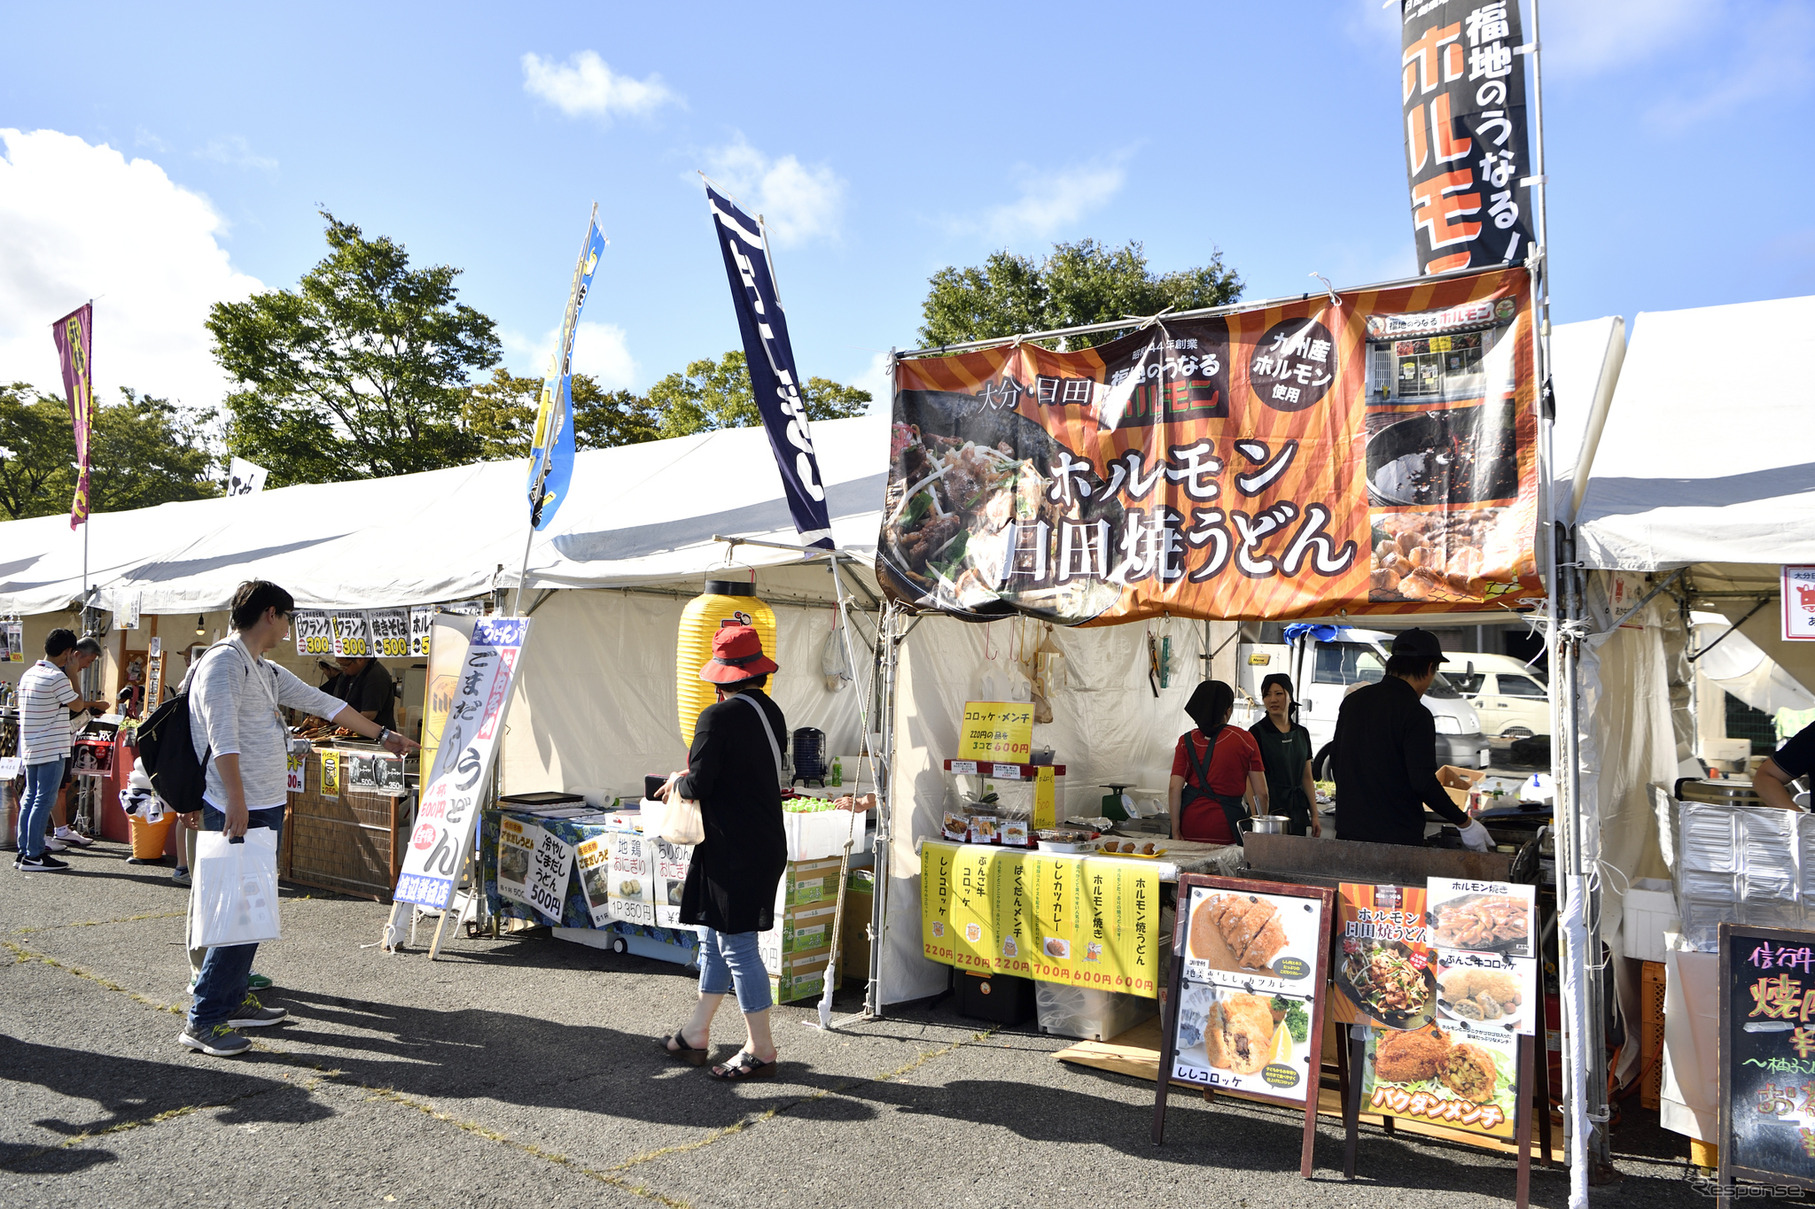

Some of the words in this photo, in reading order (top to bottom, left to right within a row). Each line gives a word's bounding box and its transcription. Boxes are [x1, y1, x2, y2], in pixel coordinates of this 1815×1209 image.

[1402, 21, 1482, 275] ホルモ
[1439, 306, 1491, 324] ホルモン
[1269, 331, 1331, 363] 九州産
[1252, 354, 1333, 387] ホルモン
[1271, 383, 1301, 404] 使用
[1047, 441, 1296, 508] ホルモン
[1000, 503, 1354, 583] 日田焼うどん
[302, 619, 330, 635] フランク
[339, 619, 367, 636] フランク
[965, 711, 1031, 724] コロッケ・メンチ
[541, 834, 566, 860] 冷やし
[613, 855, 647, 876] おにぎり
[938, 856, 948, 917] ししコロッケ
[962, 867, 971, 907] コロッケ
[976, 856, 987, 898] ぶんご牛
[1452, 881, 1508, 895] ホルモン焼き
[530, 883, 561, 916] 500円
[1013, 865, 1024, 938] ばくだんメンチ
[1053, 860, 1063, 932] ししカツカレー
[1092, 874, 1103, 940] ホルモン焼き
[1358, 908, 1420, 926] ホルモン
[1345, 921, 1427, 944] 日田焼うどん
[925, 943, 953, 960] 220円
[957, 953, 990, 969] 220円
[994, 957, 1030, 972] 220円
[1034, 964, 1070, 979] 700円
[1073, 970, 1112, 985] 600円
[1115, 975, 1153, 991] 600円
[1177, 1066, 1243, 1088] ししコロッケ
[1372, 1087, 1505, 1127] バクダンメンチ
